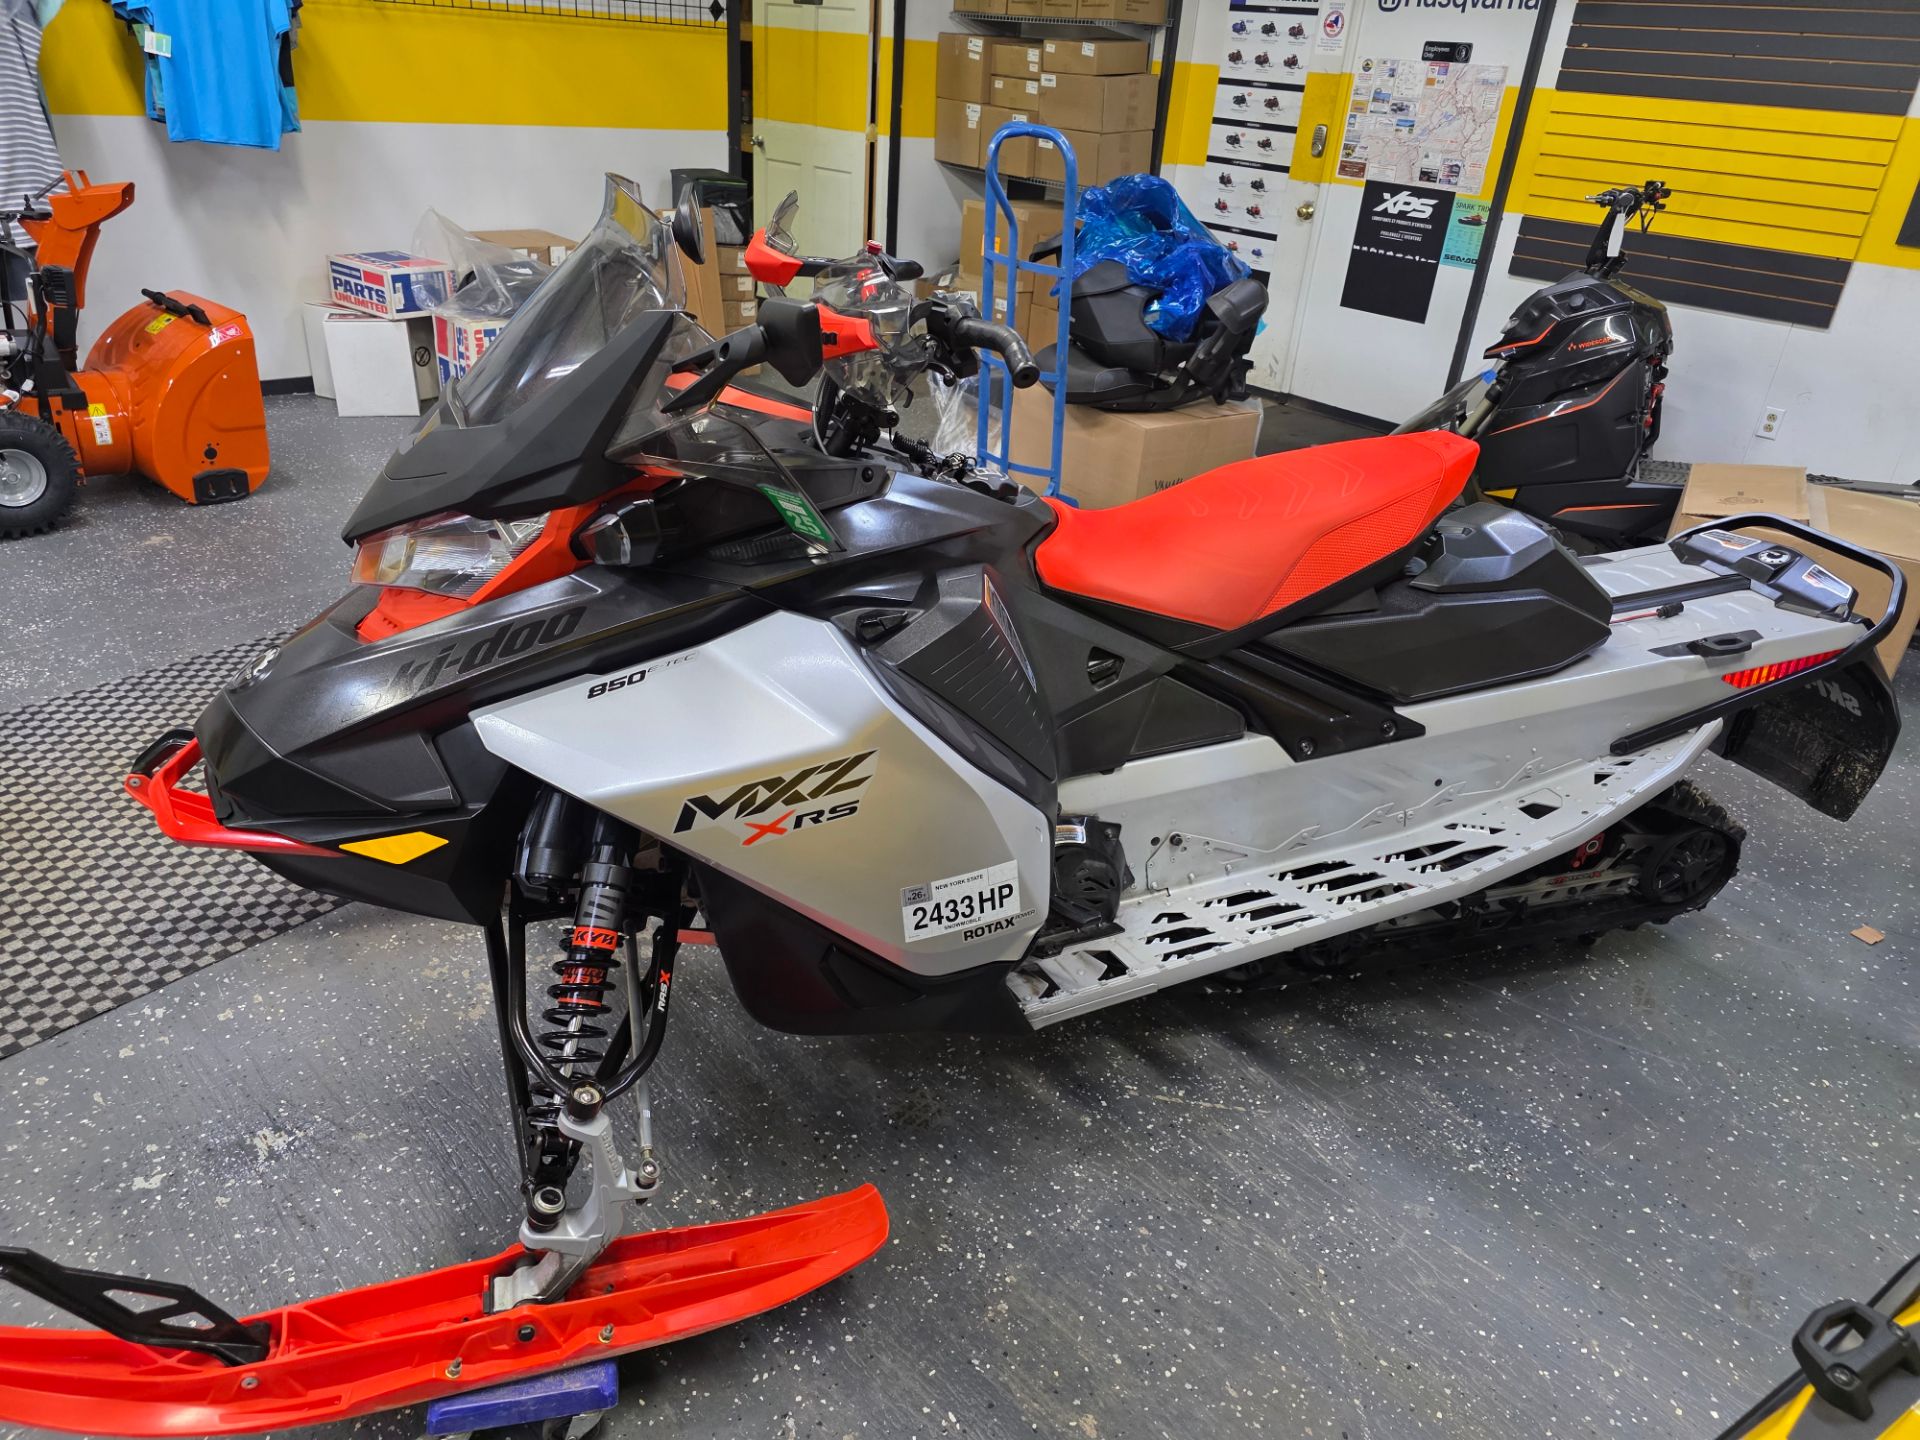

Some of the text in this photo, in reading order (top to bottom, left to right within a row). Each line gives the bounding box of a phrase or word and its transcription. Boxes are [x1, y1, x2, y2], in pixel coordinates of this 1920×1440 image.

[1424, 45, 1450, 53] Employees
[1373, 191, 1439, 219] XPS
[1456, 202, 1475, 210] SPARK
[332, 275, 387, 304] PARTS
[335, 291, 389, 314] UNLIMITED
[786, 510, 821, 535] 25
[587, 653, 697, 699] 850 E-TEC
[673, 749, 879, 834] MXZ
[967, 874, 983, 883] STATE
[911, 891, 922, 900] 26
[944, 917, 982, 930] SNOWMOBILE
[963, 917, 1016, 941] ROTAX
